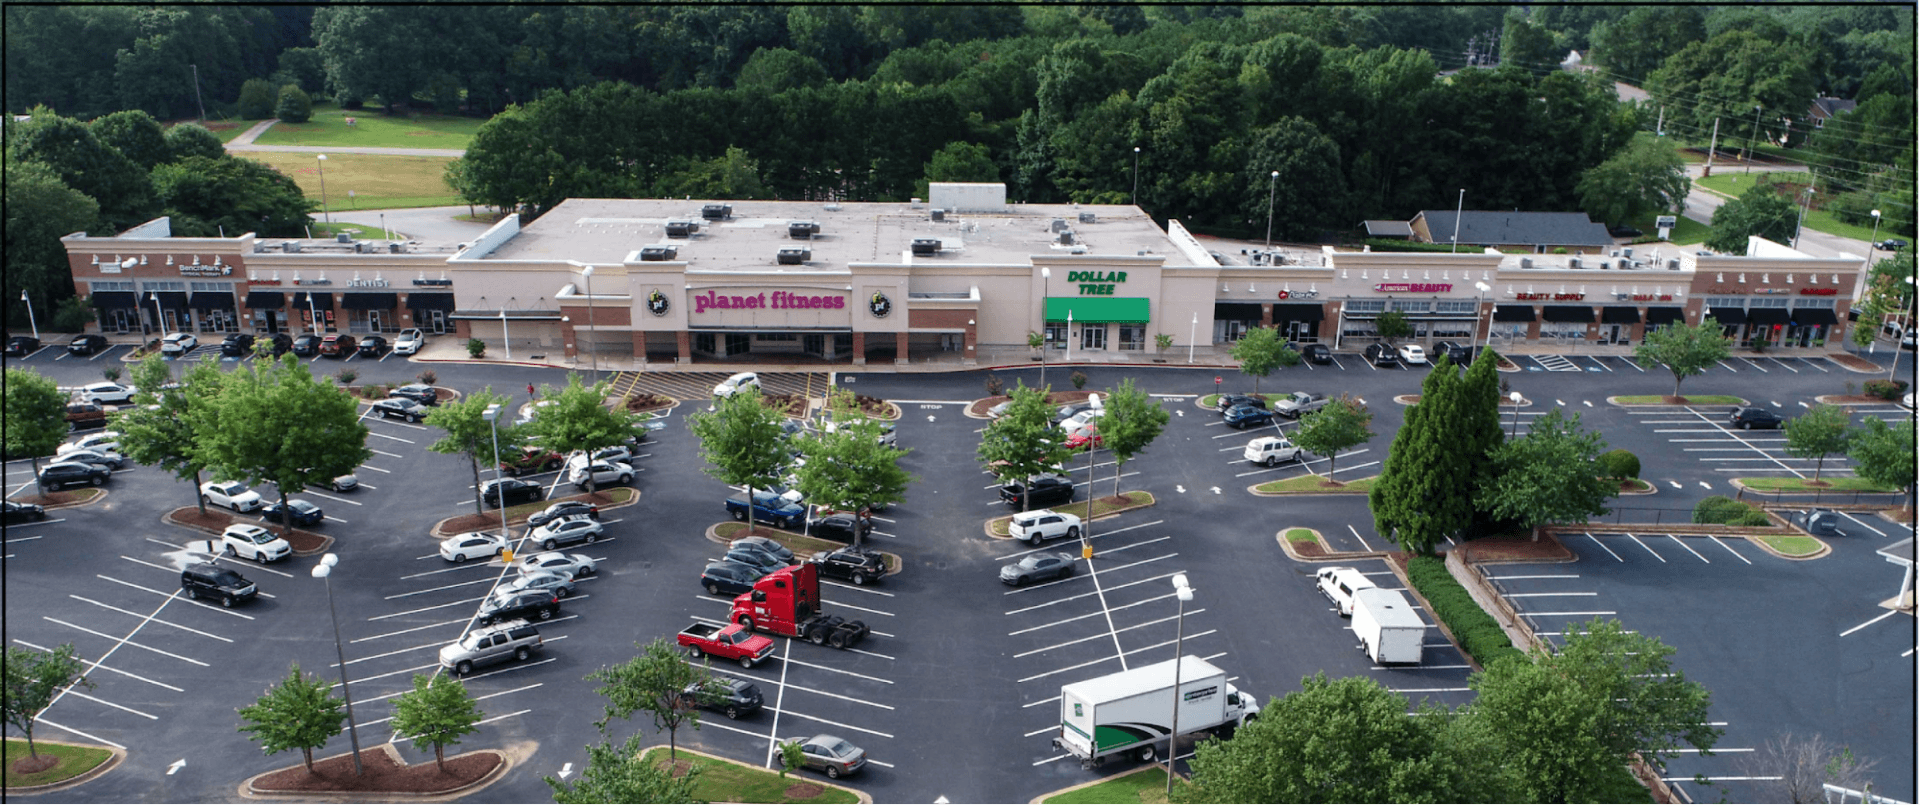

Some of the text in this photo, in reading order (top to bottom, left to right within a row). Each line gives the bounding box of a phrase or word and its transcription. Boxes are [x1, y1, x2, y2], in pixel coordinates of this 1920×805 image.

[1067, 271, 1127, 282] DOLLAR
[346, 280, 388, 288] DENTIST
[1409, 283, 1453, 292] BEAUTY
[1078, 284, 1115, 295] TREE
[653, 300, 663, 310] pf
[695, 290, 845, 313] planet fitness
[874, 301, 885, 311] pf
